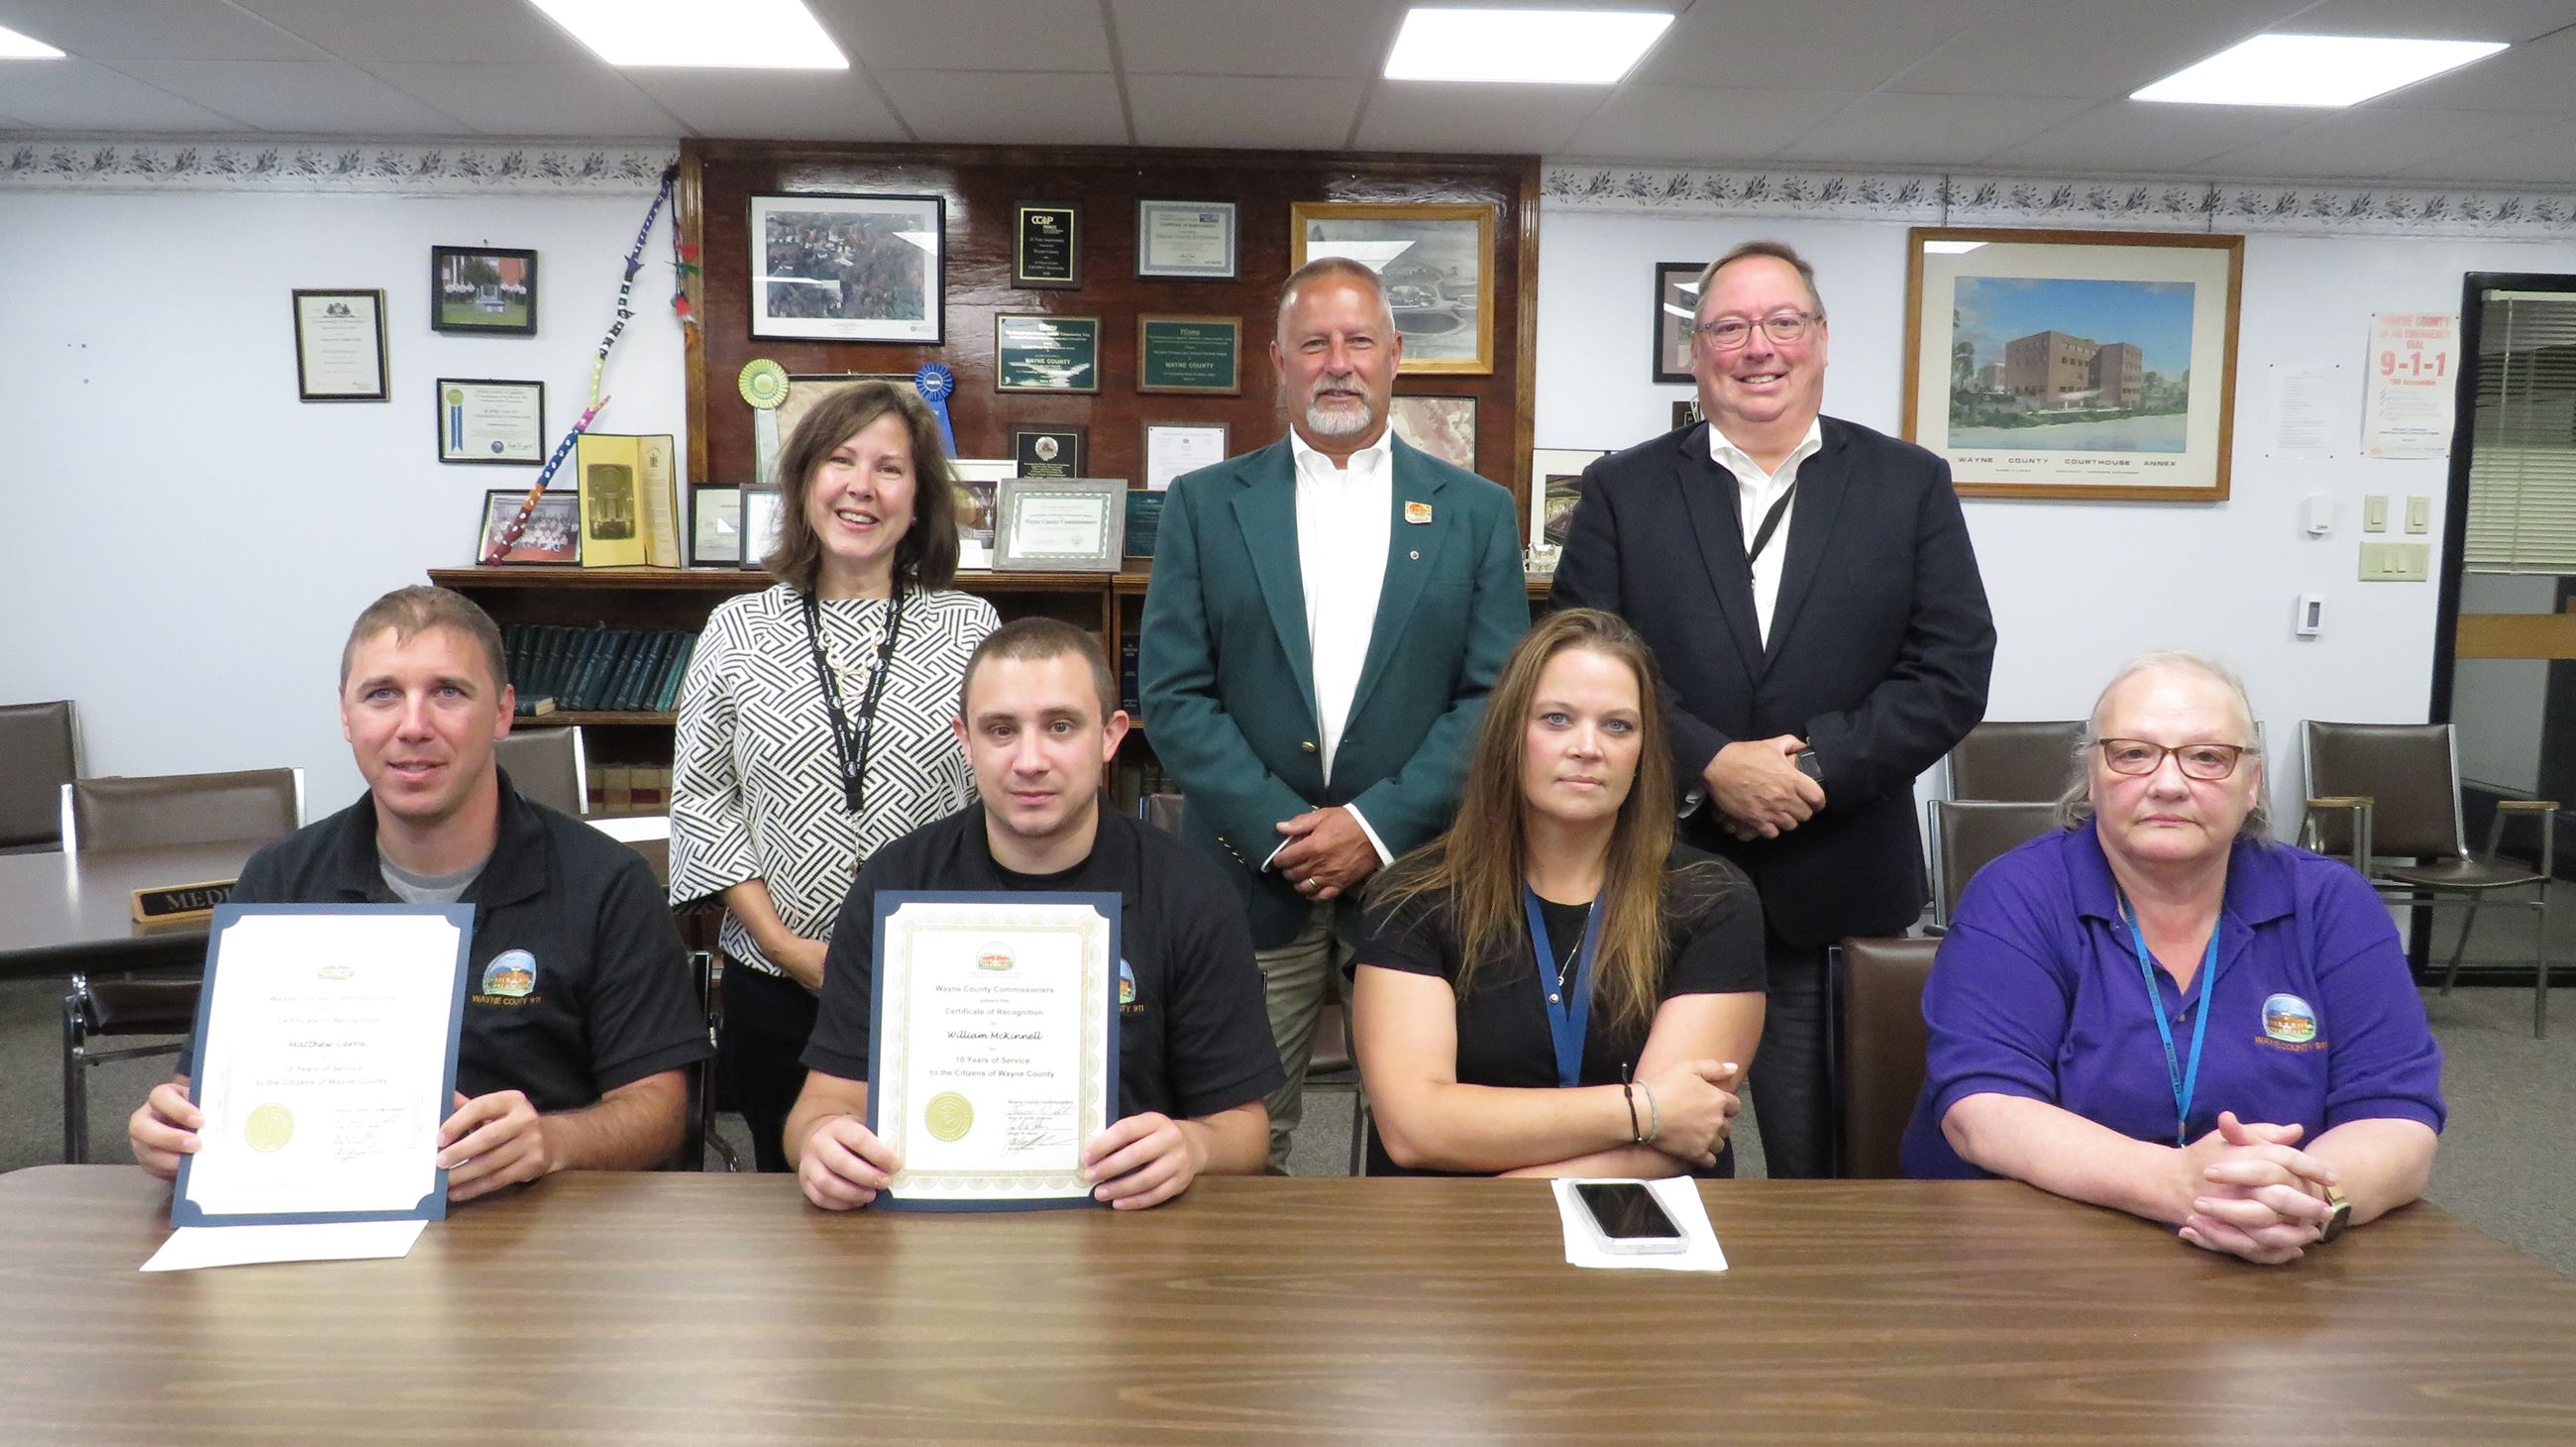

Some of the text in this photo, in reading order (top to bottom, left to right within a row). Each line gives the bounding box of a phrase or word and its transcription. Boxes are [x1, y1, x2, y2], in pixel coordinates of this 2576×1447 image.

[1031, 215, 1054, 225] CCAP
[2417, 316, 2449, 327] COUNTY
[2380, 351, 2446, 377] 9-1-1
[2064, 458, 2131, 467] COURTHOUSE
[165, 888, 234, 911] MEDI
[963, 985, 992, 994] County
[994, 985, 1054, 994] Commissioners
[472, 994, 502, 1005] WAYNE
[996, 1008, 1044, 1017] Recognition
[947, 1031, 1042, 1041] William McKinnell
[998, 1069, 1024, 1078] Wayne
[1026, 1070, 1055, 1079] County
[328, 1078, 356, 1087] Wayne
[358, 1077, 388, 1086] County
